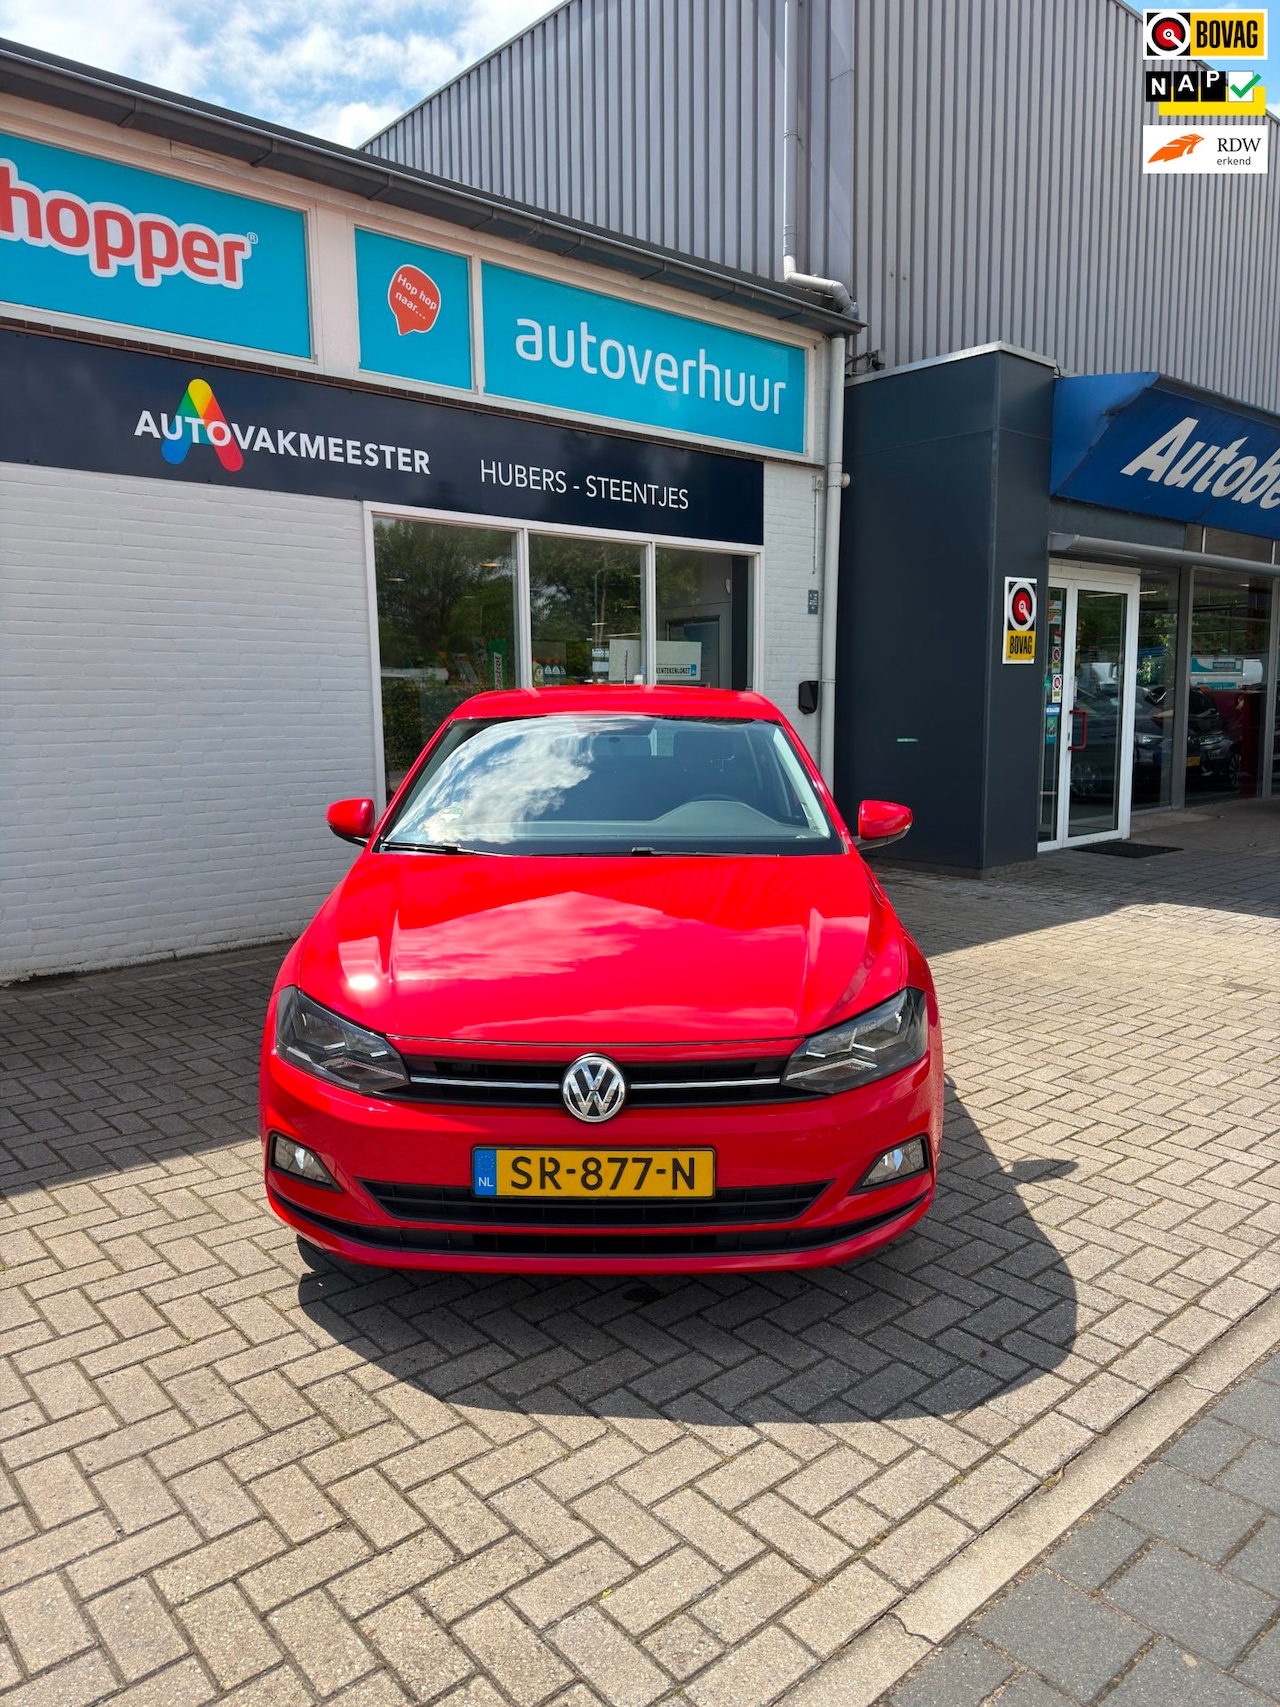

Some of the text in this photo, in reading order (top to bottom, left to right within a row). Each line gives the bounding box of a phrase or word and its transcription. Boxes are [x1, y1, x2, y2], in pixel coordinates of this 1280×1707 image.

[395, 292, 426, 320] naar...
[397, 274, 437, 310] Hop hop
[515, 318, 786, 415] autoverhuur
[134, 409, 431, 475] AUTOVAKMEESTER
[480, 459, 566, 494] HUBERS
[586, 475, 689, 510] STEENTJES
[1009, 635, 1033, 655] BOVAG
[478, 1156, 695, 1190] NL SR-877-N
